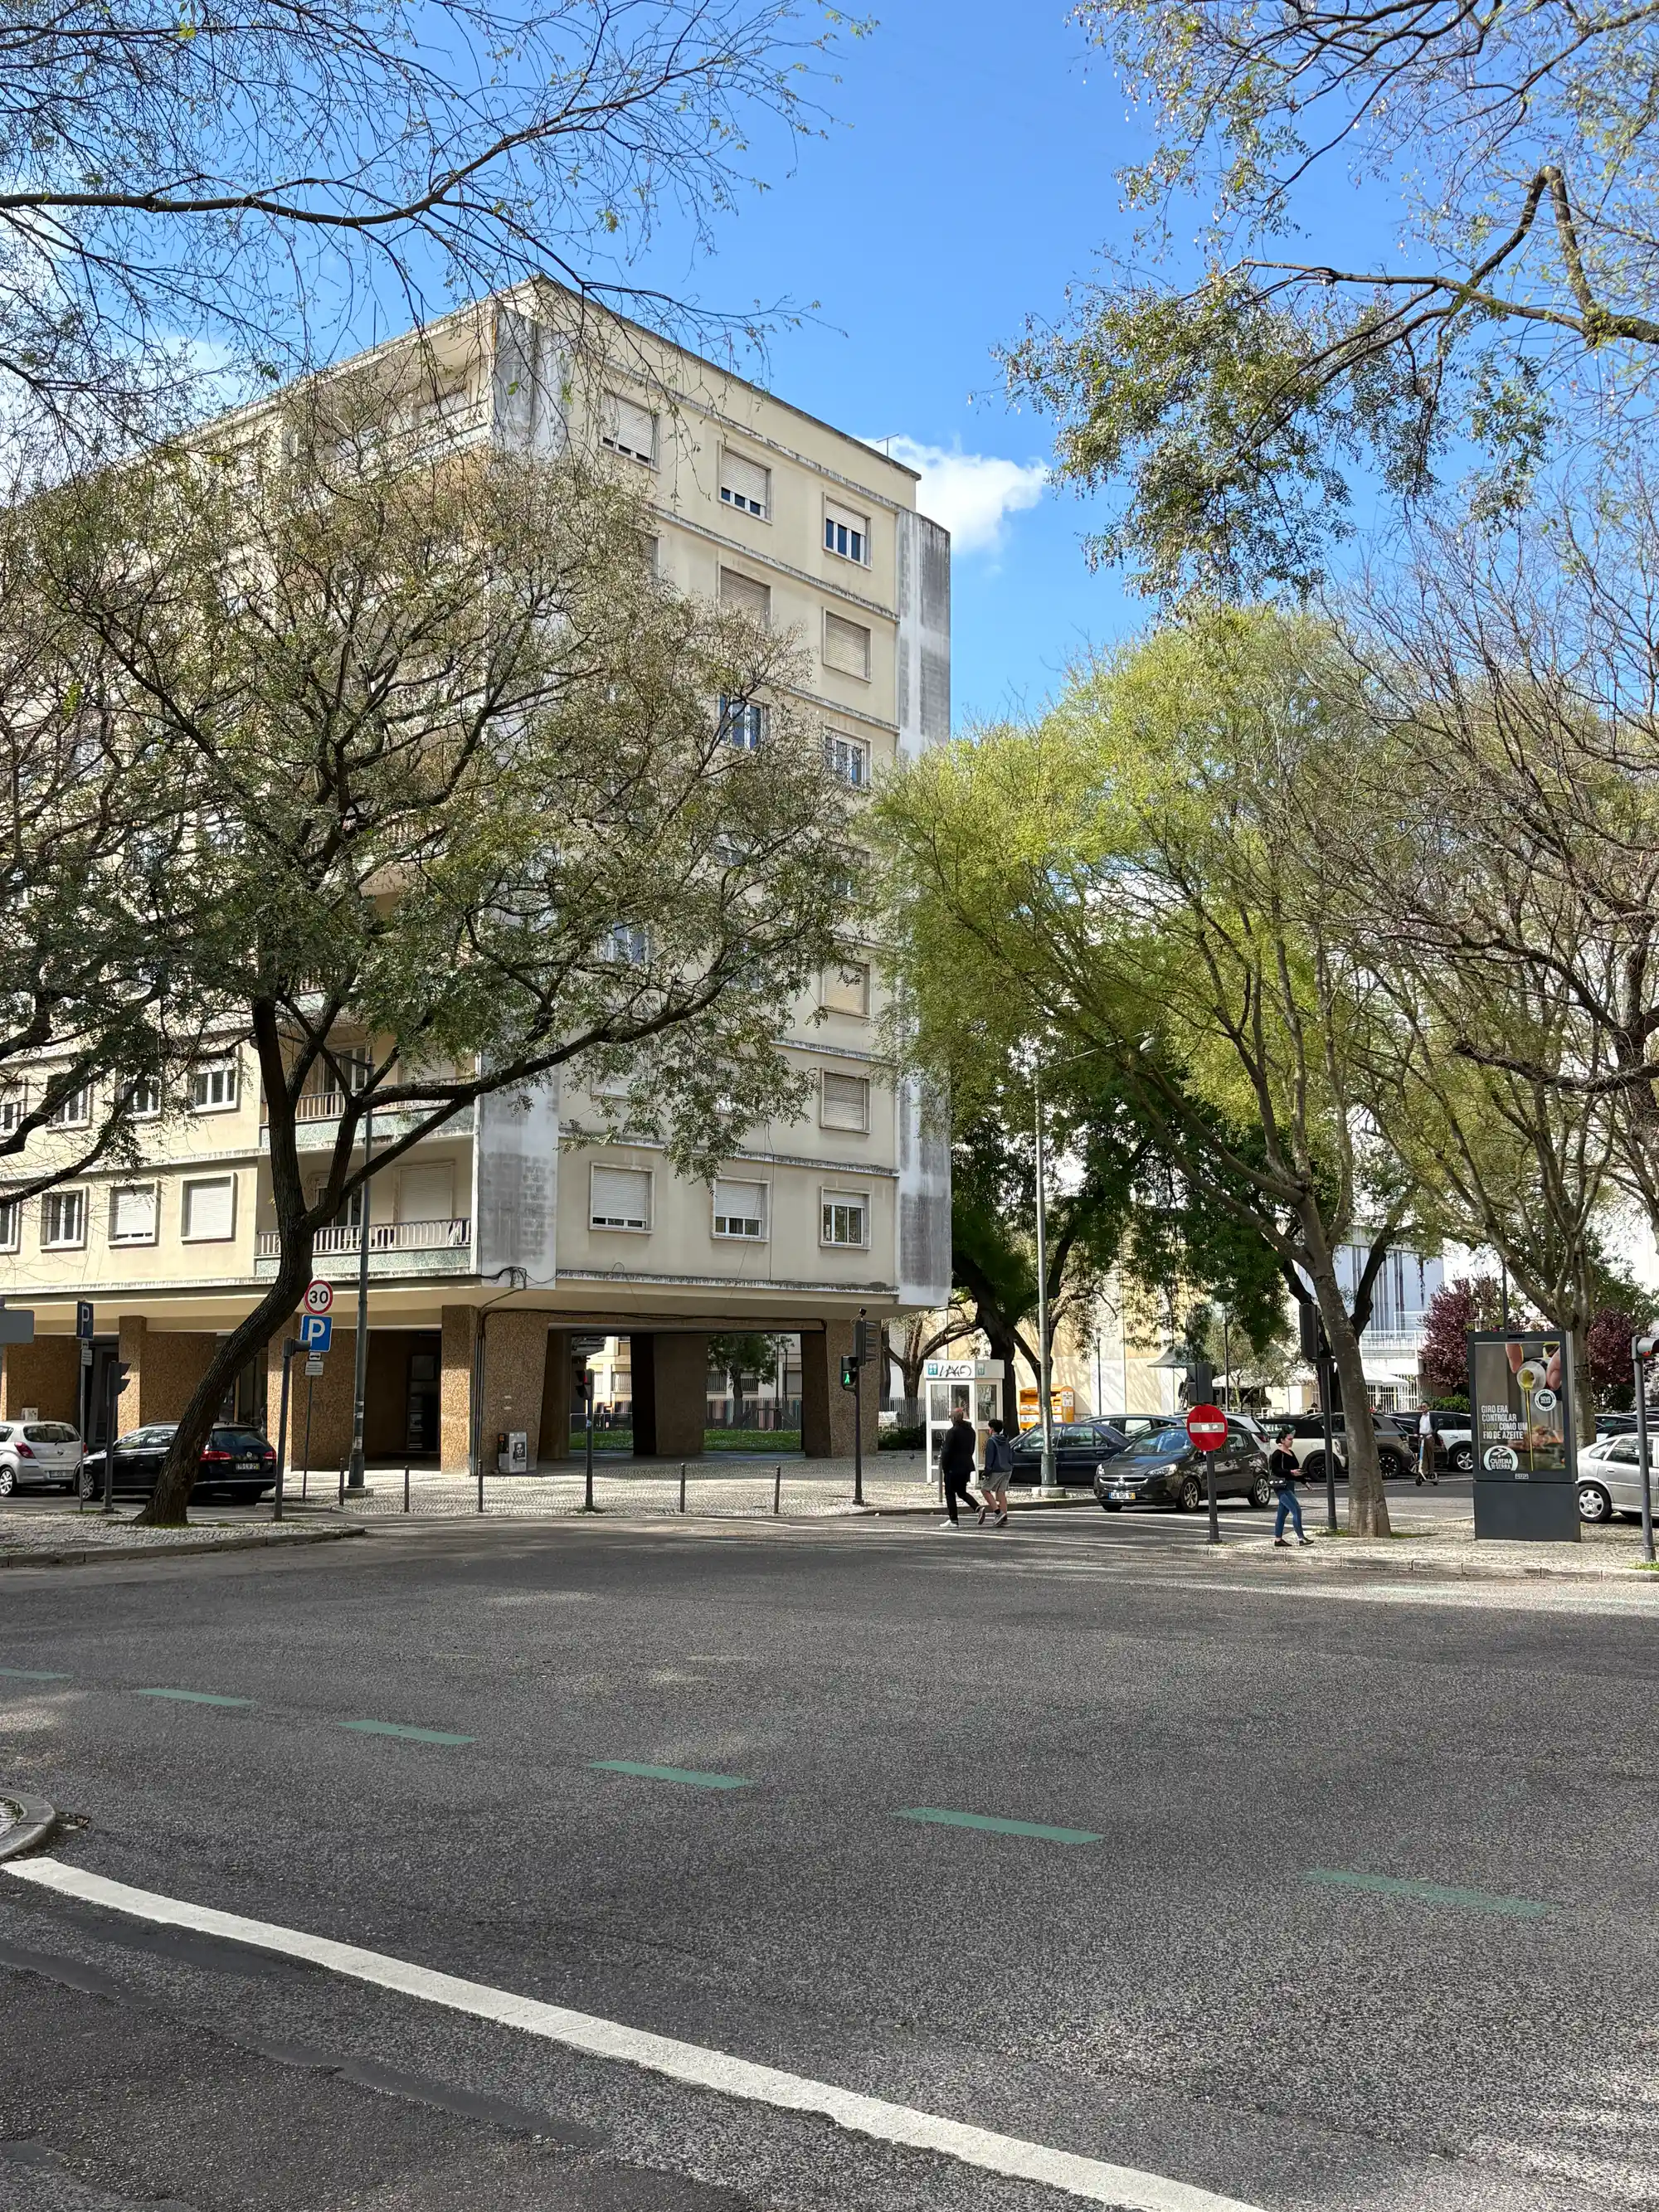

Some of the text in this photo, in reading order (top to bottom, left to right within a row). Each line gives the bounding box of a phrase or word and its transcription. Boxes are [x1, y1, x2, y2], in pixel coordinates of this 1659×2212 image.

[309, 1291, 328, 1304] 30
[81, 1305, 90, 1335] P
[308, 1318, 326, 1347] P
[1481, 1405, 1509, 1413] GIRO ERA
[1481, 1413, 1517, 1422] CONTROLAR
[1483, 1422, 1528, 1431] TUDO COMO UM
[1501, 1431, 1524, 1439] AZEITE
